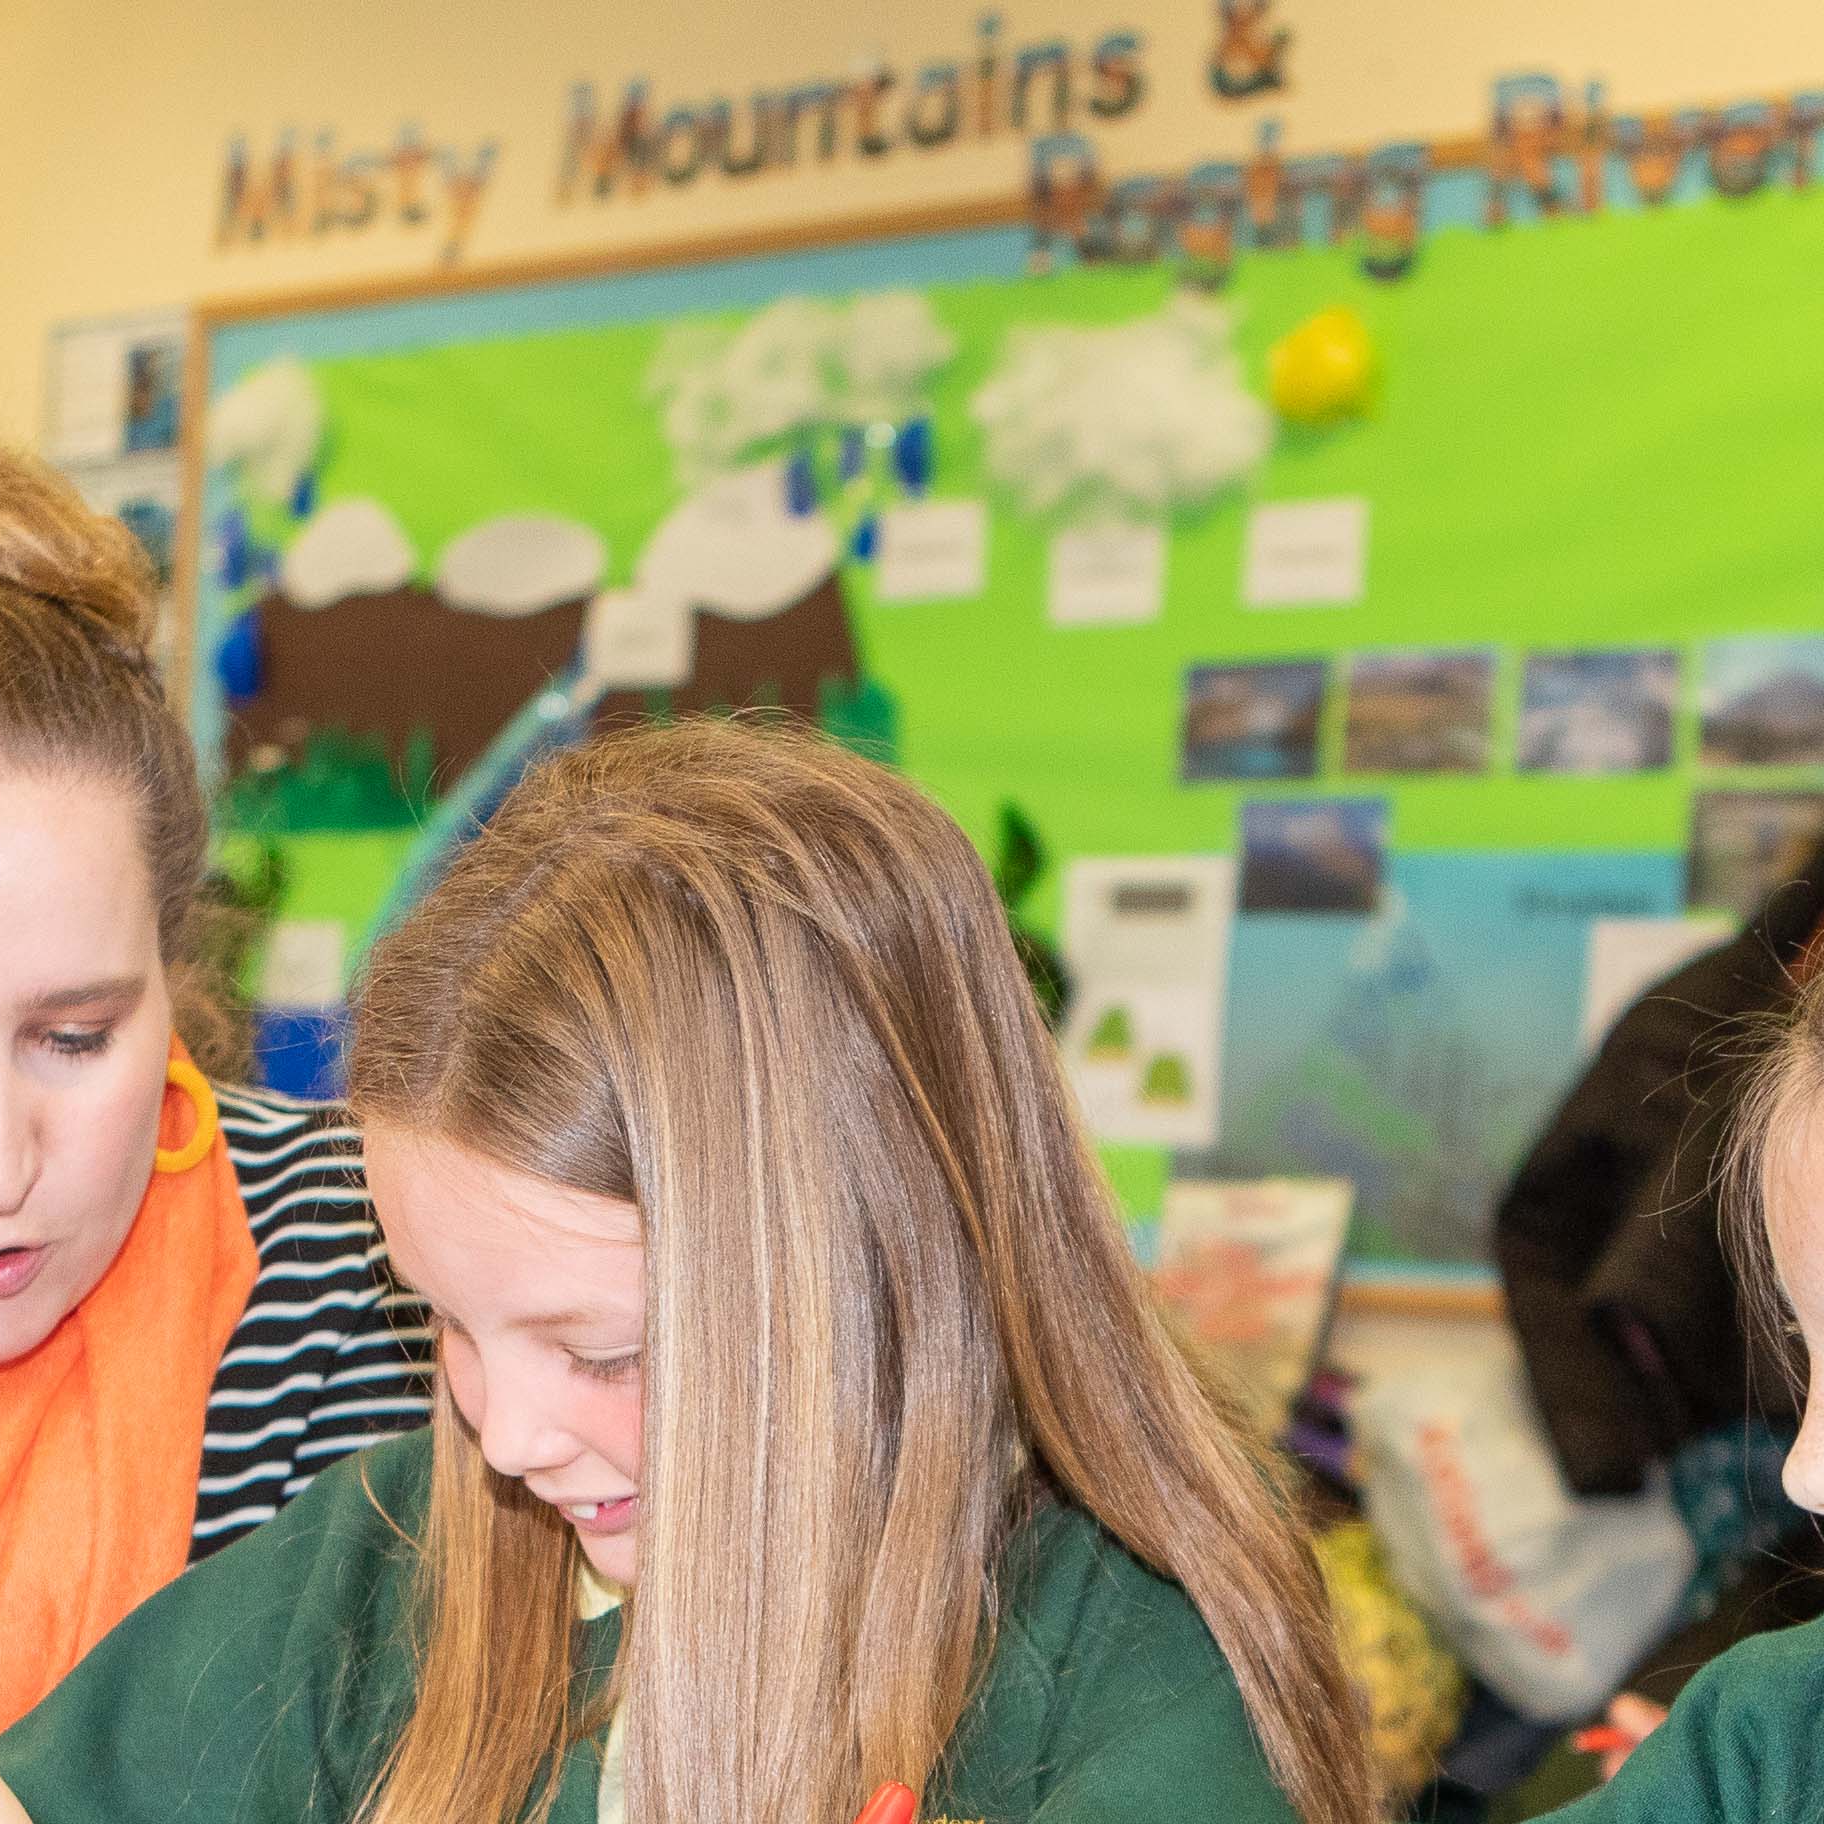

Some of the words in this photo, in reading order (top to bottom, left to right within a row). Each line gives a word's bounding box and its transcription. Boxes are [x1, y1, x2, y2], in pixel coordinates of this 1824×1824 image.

[216, 118, 498, 266] Misty
[554, 8, 1150, 206] Mountains
[1206, 0, 1294, 100] &
[1028, 130, 1428, 294] Raging
